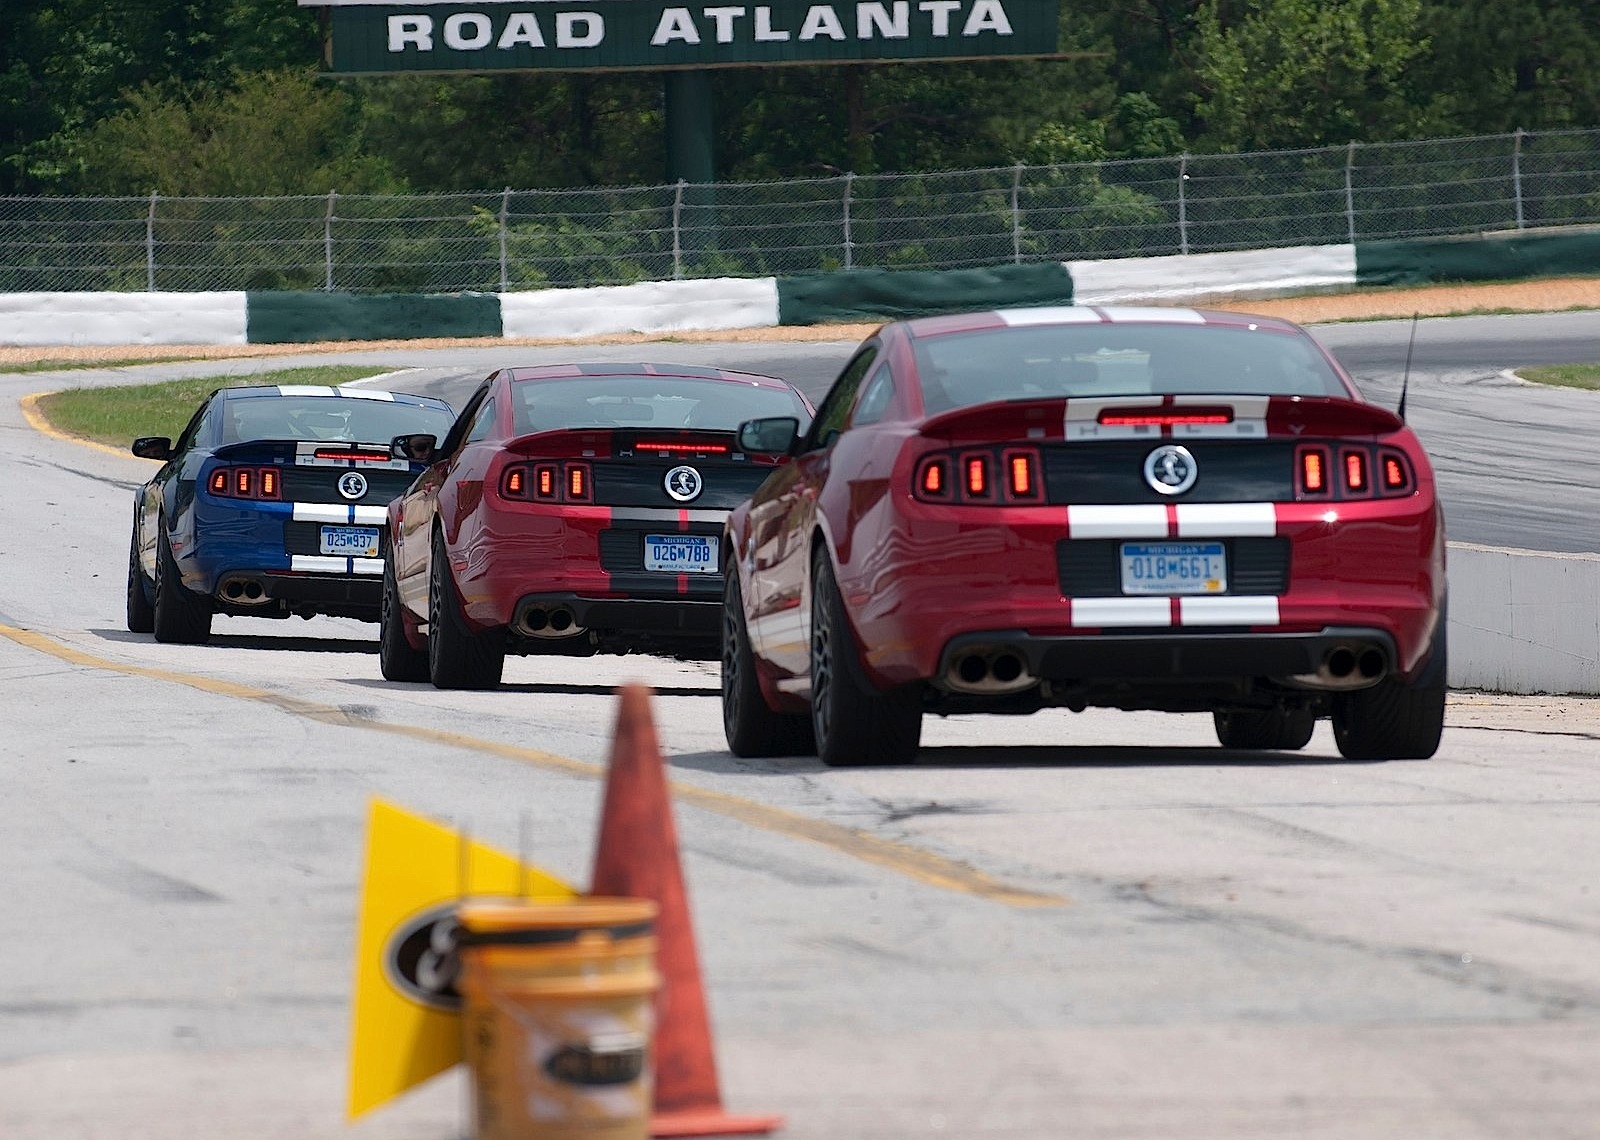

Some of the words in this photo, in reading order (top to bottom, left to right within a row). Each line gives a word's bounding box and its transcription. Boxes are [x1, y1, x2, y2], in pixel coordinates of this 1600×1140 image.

[387, 11, 606, 53] ROAD
[650, 0, 1014, 46] ATLANTA
[663, 537, 700, 545] MICHIGAN
[1147, 545, 1199, 554] MICHIGAN
